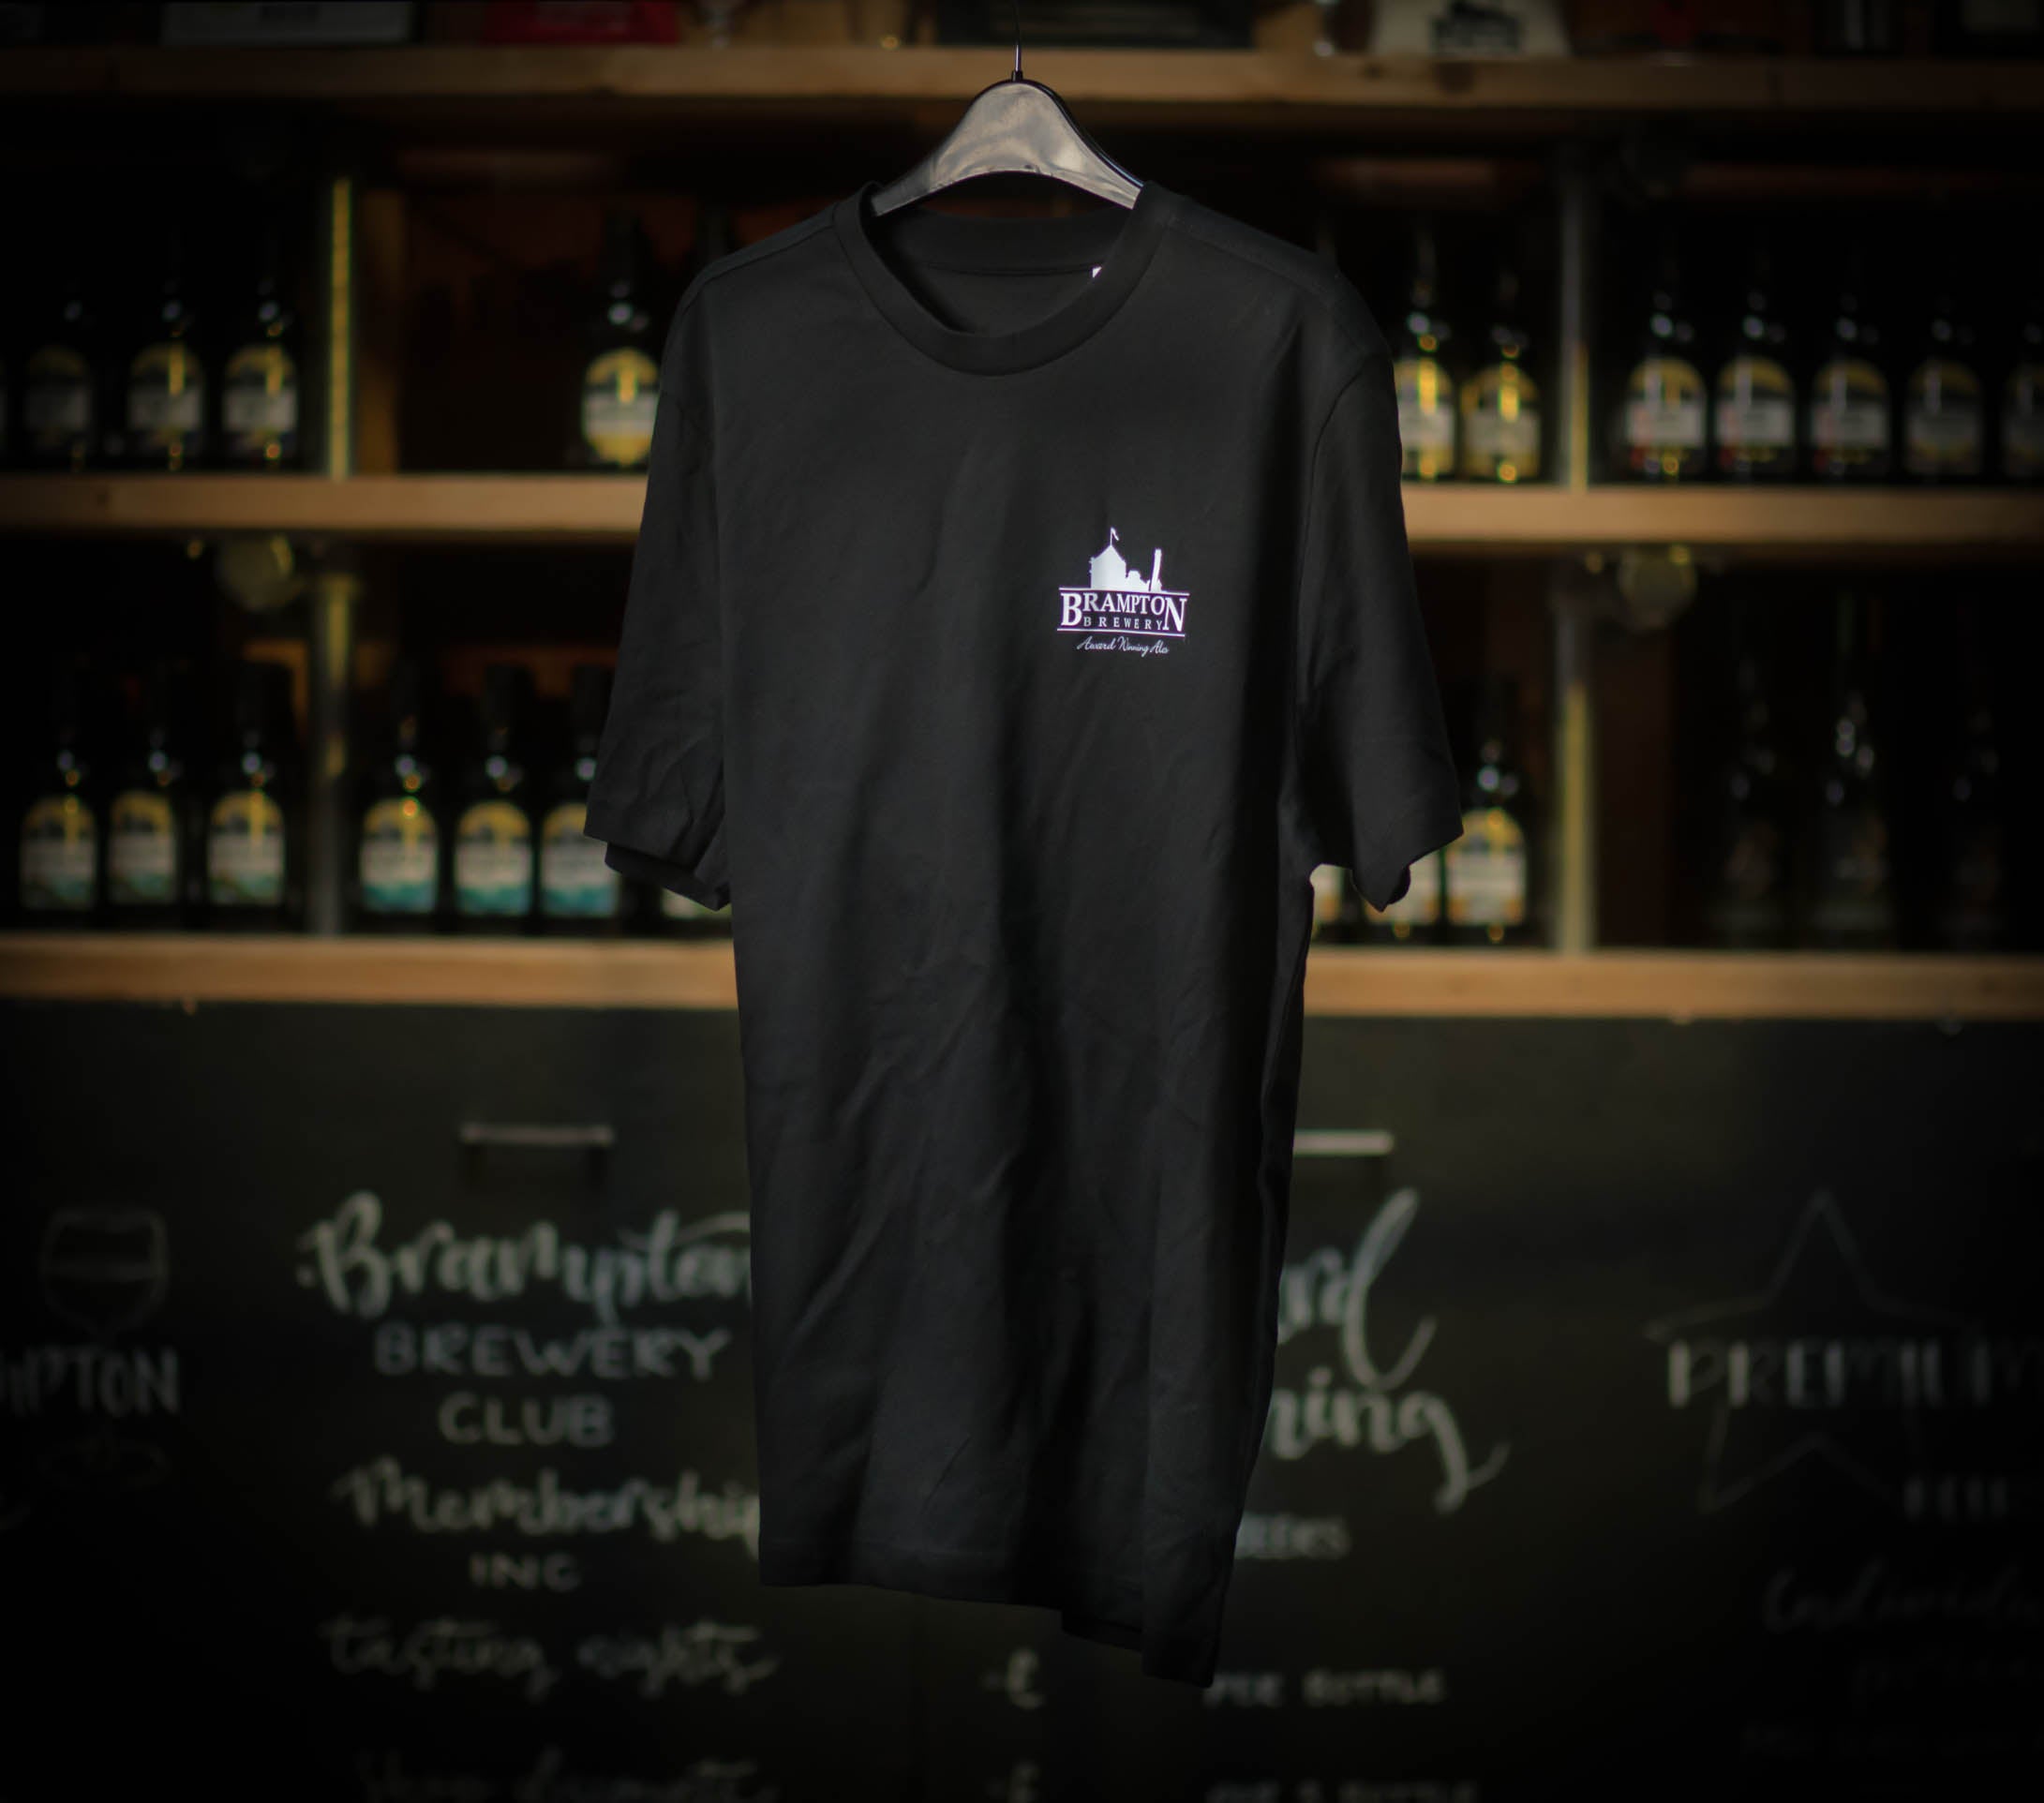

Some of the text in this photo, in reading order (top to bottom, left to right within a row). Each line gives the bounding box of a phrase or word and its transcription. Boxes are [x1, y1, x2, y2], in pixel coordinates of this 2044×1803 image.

[1061, 592, 1187, 632] BRAMPTON
[1083, 617, 1163, 630] BREWERY
[1076, 635, 1116, 650] Award
[294, 1190, 751, 1327] Brampto
[373, 1320, 733, 1381] BREWERY
[437, 1390, 616, 1449] CLUB
